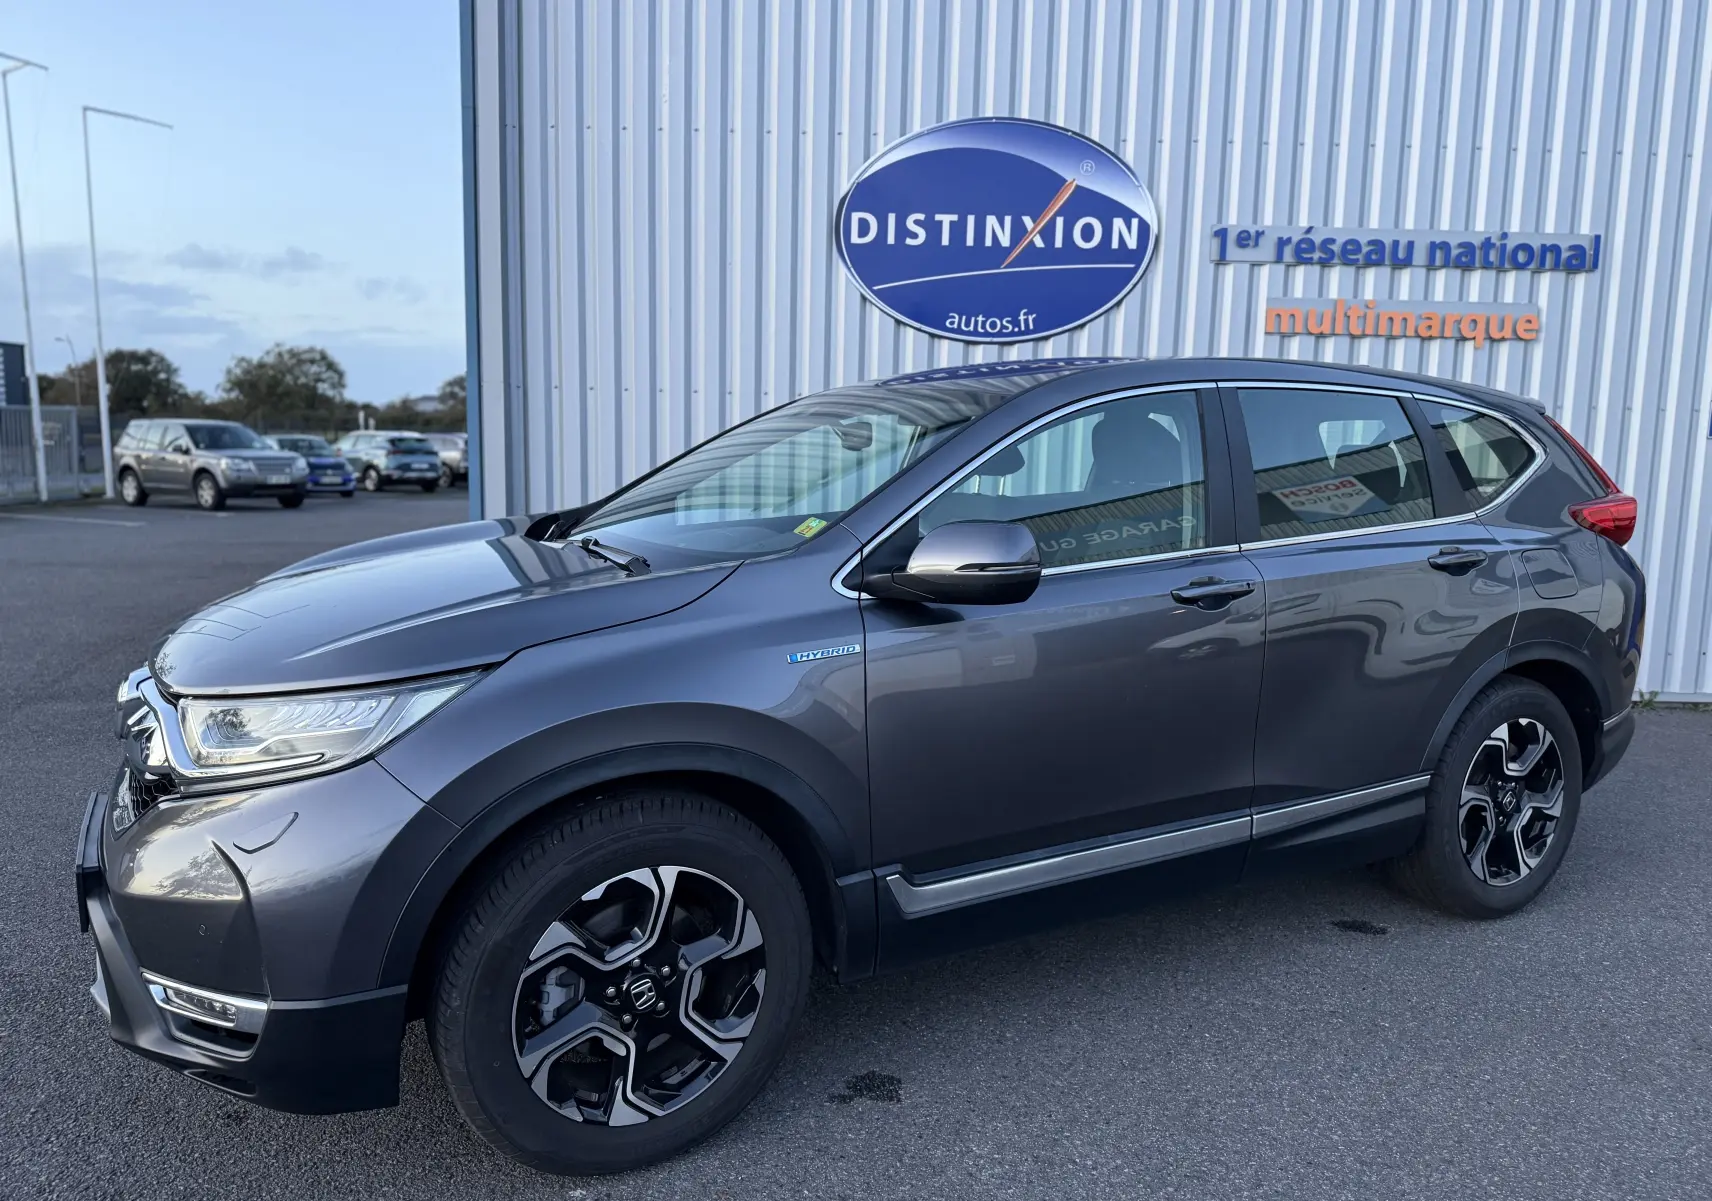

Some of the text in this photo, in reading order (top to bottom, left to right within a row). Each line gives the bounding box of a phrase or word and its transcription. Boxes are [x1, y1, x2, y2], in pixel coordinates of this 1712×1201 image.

[850, 211, 1139, 250] DISTINXION
[1213, 226, 1601, 270] 1er réseau national
[945, 308, 1037, 333] autos.fr
[1265, 298, 1540, 349] multimarque
[800, 645, 857, 661] HYBRID
